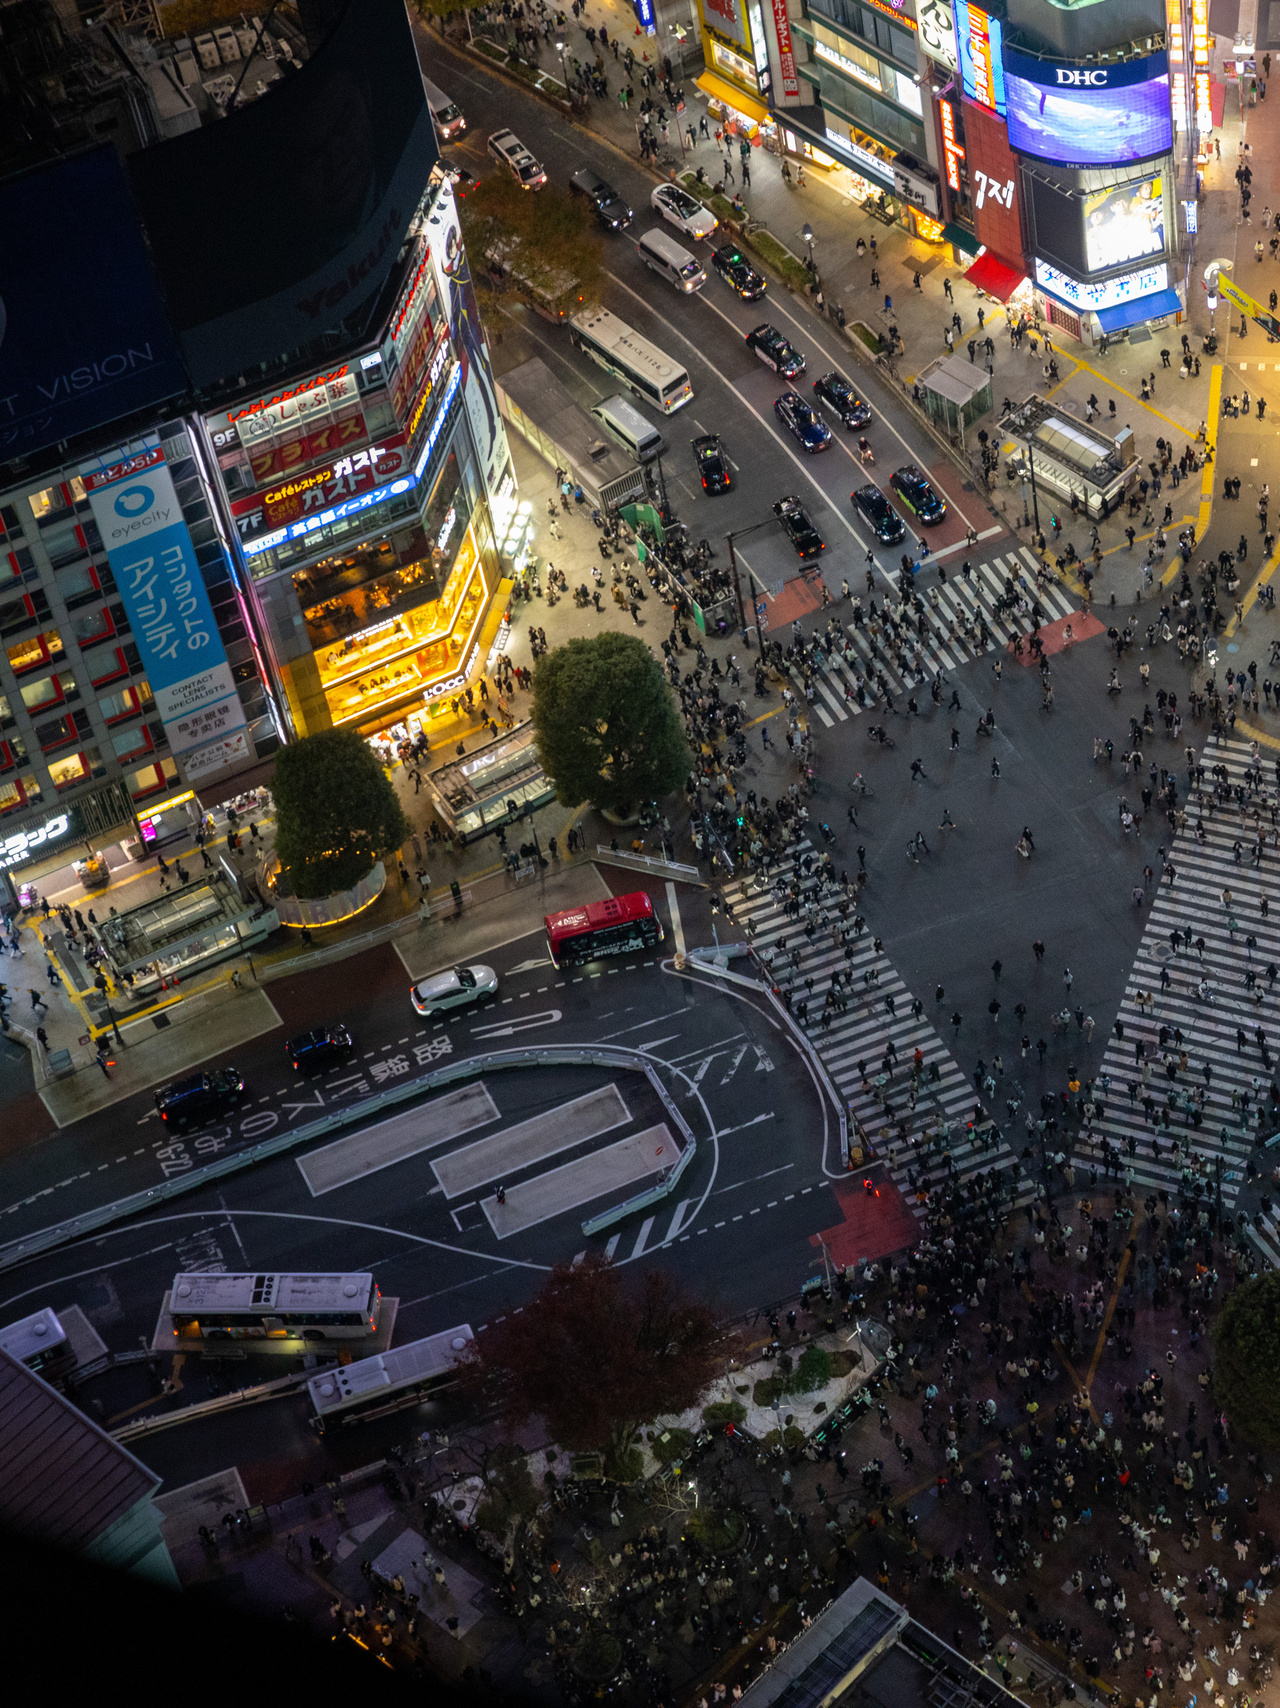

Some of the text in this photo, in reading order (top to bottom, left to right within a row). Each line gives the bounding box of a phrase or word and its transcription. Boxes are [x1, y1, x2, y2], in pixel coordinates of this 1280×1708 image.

[1056, 68, 1108, 86] DHC
[36, 342, 154, 400] VISION
[227, 364, 349, 423] しゃぶしゃぶバイキング
[280, 380, 349, 420] しゃぶ葉
[213, 427, 236, 446] 9F
[265, 470, 332, 504] Caféレストラン
[333, 447, 386, 479] ガスト
[379, 459, 400, 472] ガスト
[302, 472, 367, 510] ガスト
[111, 507, 171, 539] eyecity
[237, 514, 263, 533] 7F
[123, 556, 180, 659] アイシティ
[160, 544, 210, 651] コンタクトの
[167, 683, 226, 713] SPECIALISTS
[171, 673, 214, 696] CONTACT
[183, 684, 207, 699] LENS
[194, 1034, 453, 1154] 路線バスのみ
[155, 1141, 194, 1178] 6-22
